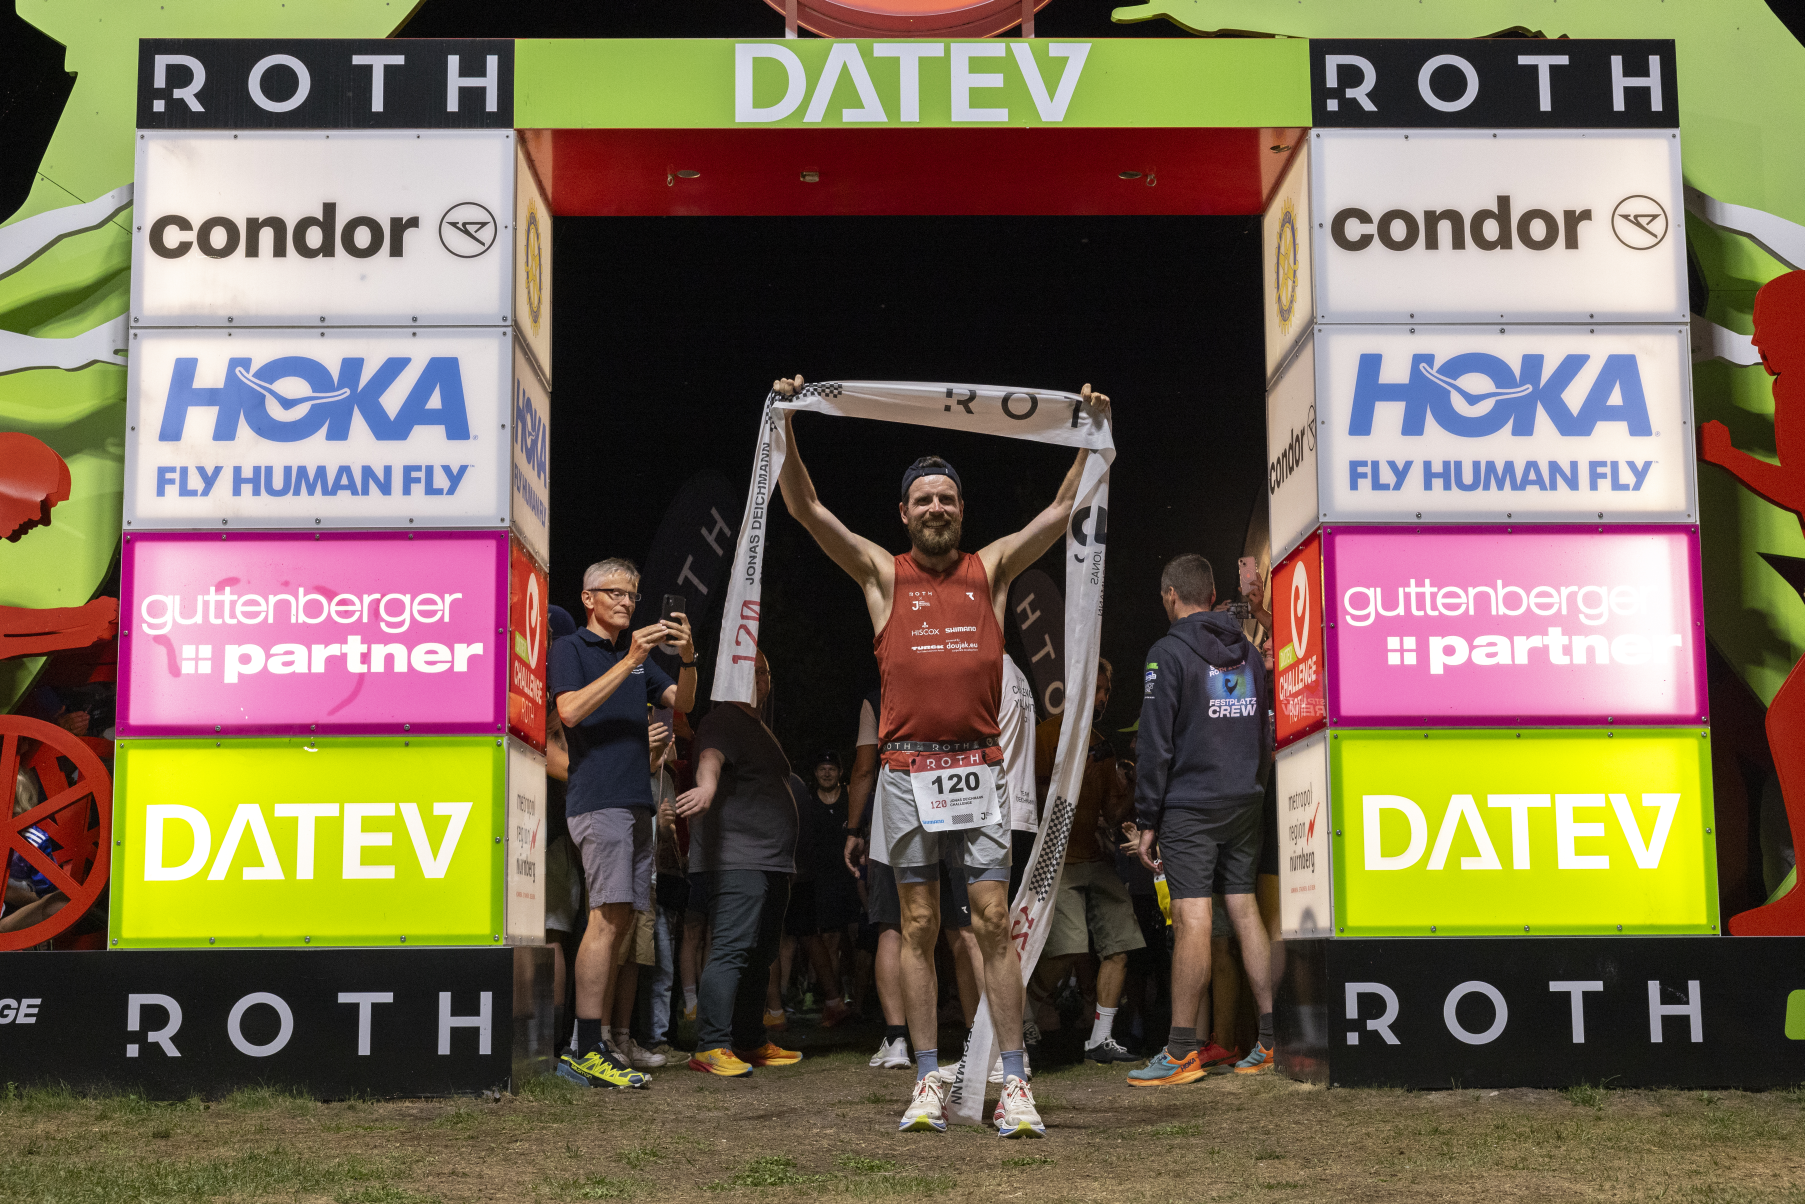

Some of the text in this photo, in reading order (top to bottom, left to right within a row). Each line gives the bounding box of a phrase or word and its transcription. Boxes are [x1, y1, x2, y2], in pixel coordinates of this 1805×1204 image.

[153, 54, 499, 113] ROTH
[734, 42, 1092, 123] DATEV
[1325, 54, 1663, 113] ROTH
[147, 201, 420, 259] condor
[1330, 194, 1593, 252] condor
[157, 355, 472, 443] HOKA
[1346, 351, 1655, 438] HOKA
[515, 378, 547, 488] HOKA
[155, 463, 470, 498] FLY HUMAN FLY
[1269, 425, 1306, 495] condor
[1348, 459, 1654, 491] FLY HUMAN FLY
[745, 442, 771, 586] JONAS DEICHMANN
[141, 586, 463, 635] guttenberger
[1343, 578, 1658, 627] guttenberger
[911, 628, 940, 637] HISCOX
[945, 626, 977, 634] SHIMANO
[946, 641, 978, 650] doujak.eu
[1429, 626, 1682, 675] partner
[223, 635, 483, 684] partner
[514, 659, 543, 705] CHALLENGE
[1279, 655, 1317, 701] CHALLENGE
[520, 697, 535, 727] ROTH
[1208, 704, 1257, 718] CREW
[1209, 697, 1257, 707] FESTPLATZ
[926, 753, 980, 770] ROTH
[931, 771, 981, 795] 120
[930, 799, 948, 810] 120
[1288, 781, 1313, 813] metropol
[143, 801, 474, 882] DATEV
[1288, 818, 1307, 846] region
[1361, 792, 1682, 872] DATEV
[1289, 846, 1315, 874] nürnberg
[126, 991, 493, 1058] ROTH
[1344, 979, 1704, 1046] ROTH
[1180, 1057, 1197, 1072] HOKA
